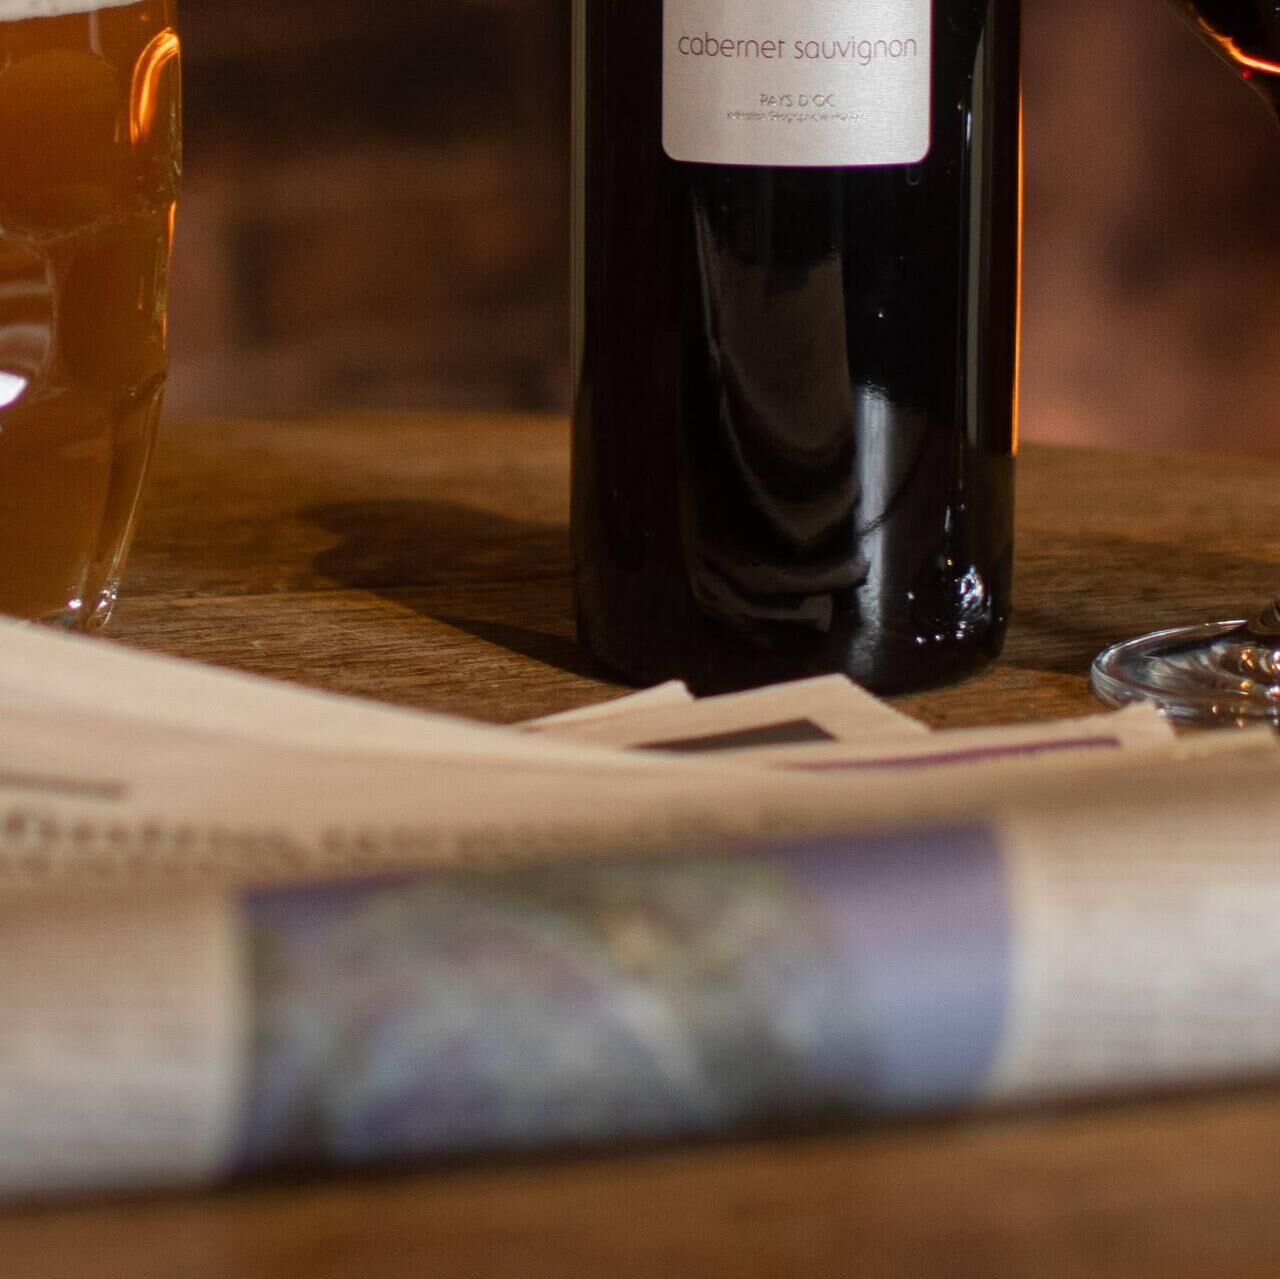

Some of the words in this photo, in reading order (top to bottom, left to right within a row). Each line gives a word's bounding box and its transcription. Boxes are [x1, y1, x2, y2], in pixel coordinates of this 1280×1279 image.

[678, 32, 786, 59] cabernet
[793, 36, 918, 66] sauvignon
[759, 93, 793, 107] PAYS
[798, 94, 837, 108] D'OC
